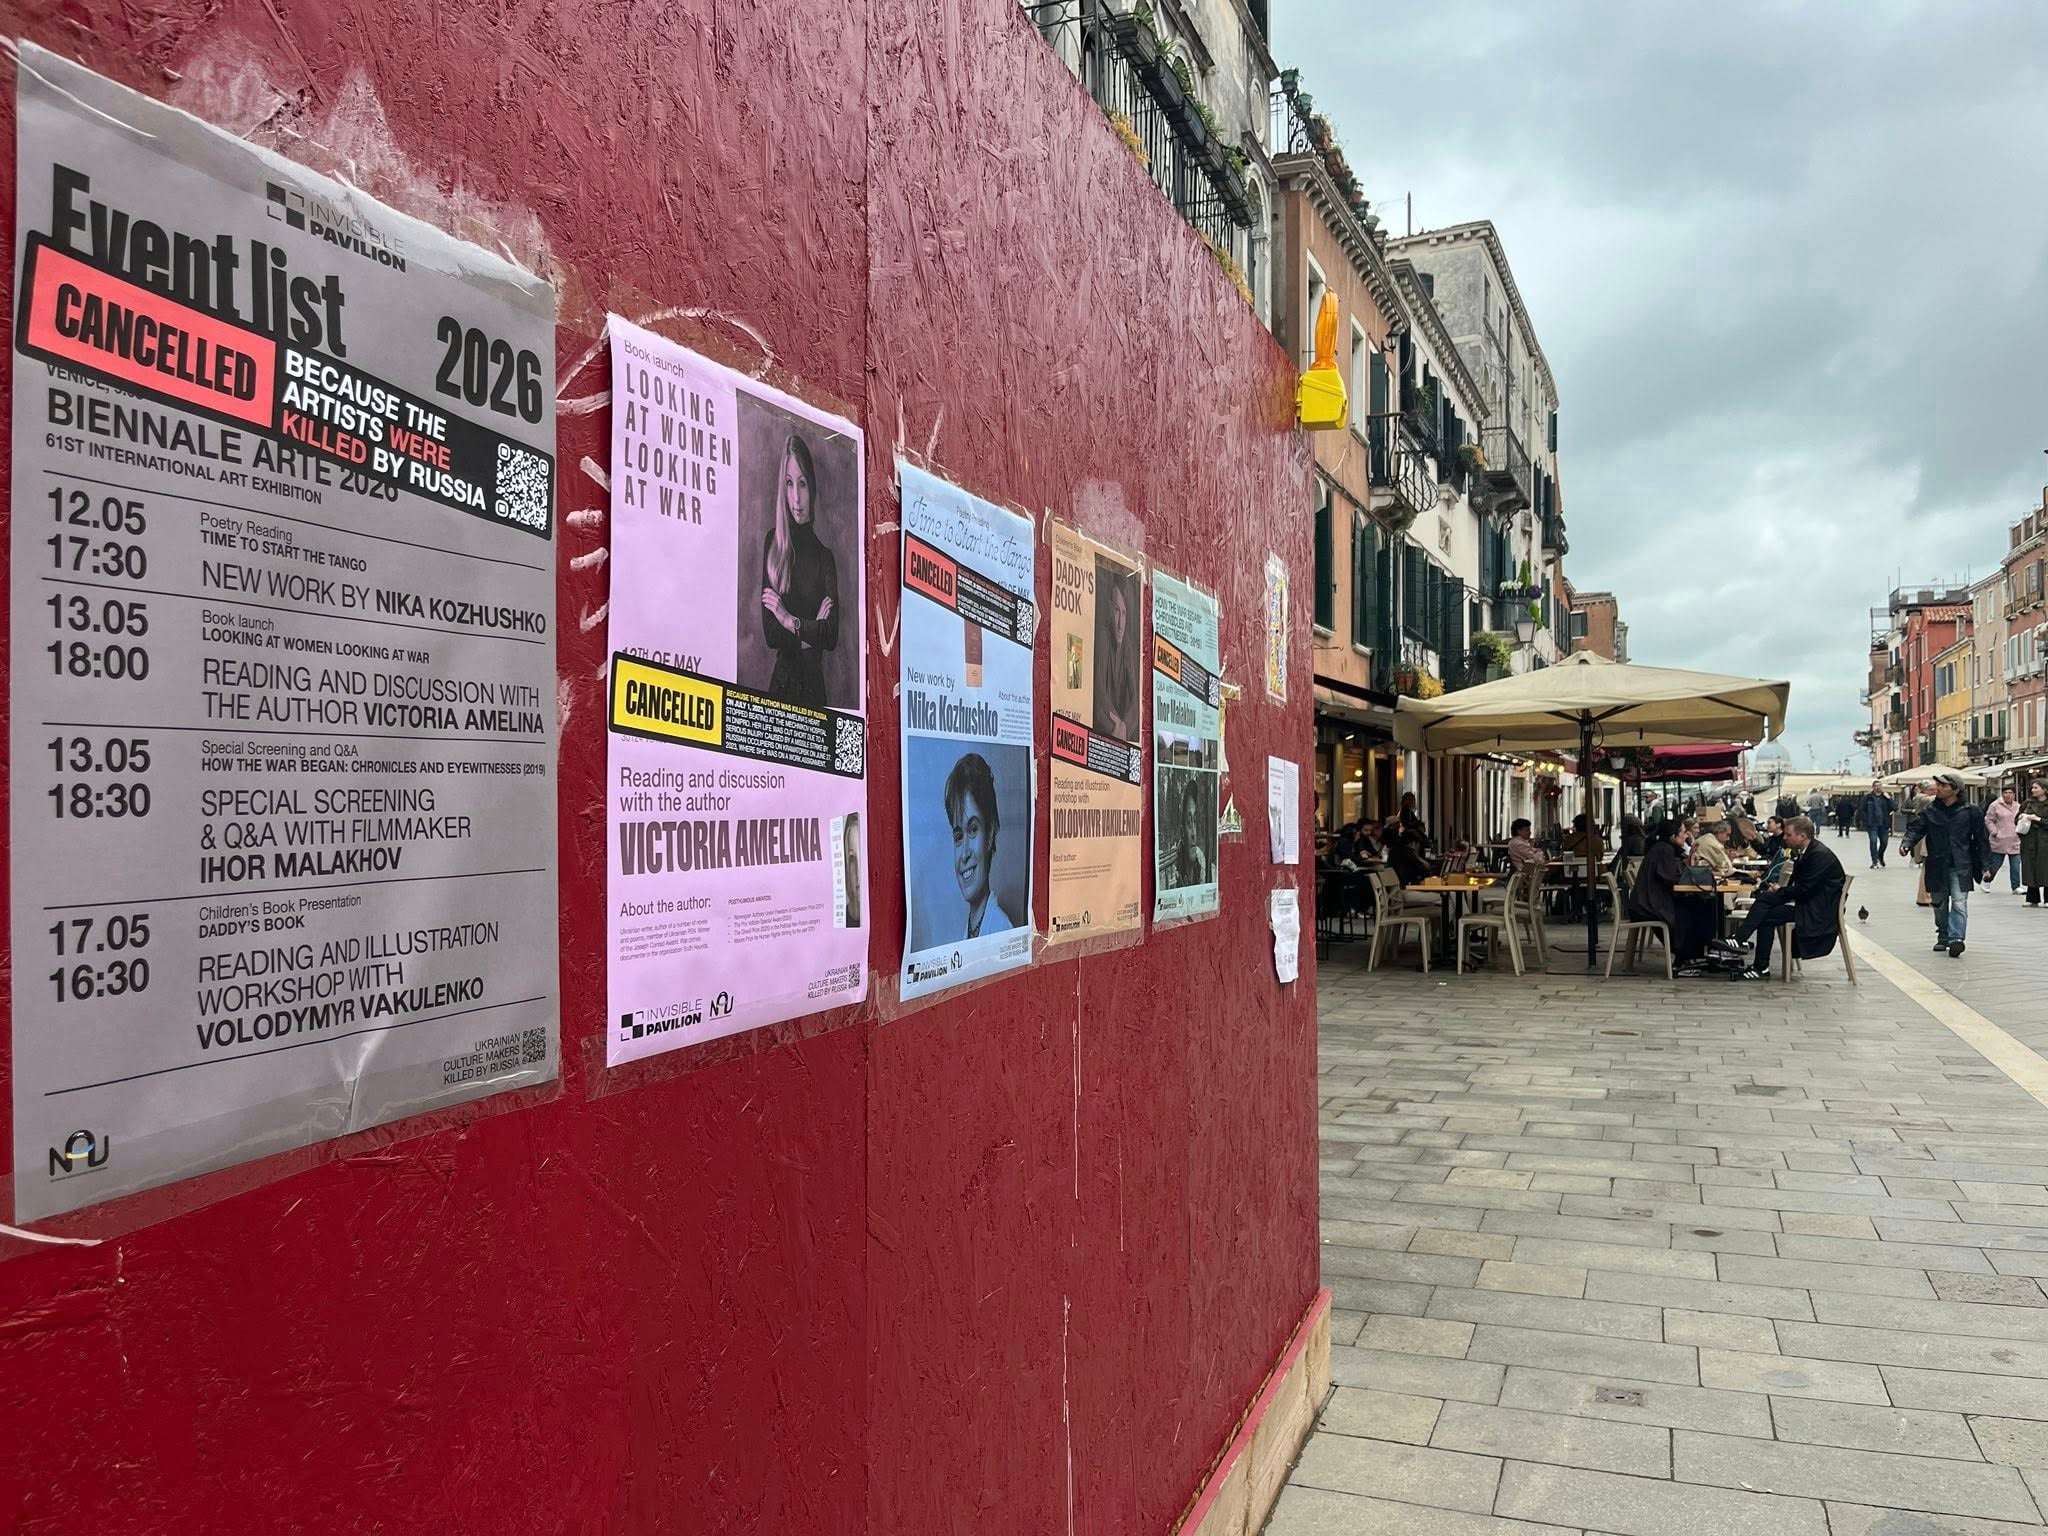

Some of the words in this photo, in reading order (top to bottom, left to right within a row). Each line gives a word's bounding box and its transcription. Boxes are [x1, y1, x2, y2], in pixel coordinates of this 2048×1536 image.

[310, 220, 407, 273] PAVILION
[311, 200, 404, 252] INVISIBLE
[53, 162, 240, 320] Event
[251, 239, 346, 358] list
[55, 283, 257, 402] CANCELLED
[624, 339, 651, 364] Book
[652, 355, 685, 378] launch
[436, 316, 542, 425] 2026
[285, 349, 400, 421] BECAUSE
[405, 402, 447, 441] THE
[626, 363, 715, 427] LOOKING
[48, 387, 242, 464] BIENNALE
[252, 439, 332, 486] ARTE
[282, 382, 384, 442] ARTISTS
[389, 424, 451, 471] WERE
[625, 400, 649, 436] AT
[661, 413, 731, 467] WOMEN
[46, 433, 84, 455] 61ST
[89, 443, 215, 481] INTERNATIONAL
[219, 470, 249, 488] ART
[252, 476, 322, 505] EXHIBITION
[282, 410, 367, 464] KILLED
[373, 447, 405, 478] BY
[409, 463, 487, 511] RUSSIA
[624, 437, 717, 496] LOOKING
[47, 487, 147, 536] 12.05
[624, 475, 647, 510] AT
[660, 485, 702, 525] WAR
[200, 512, 243, 535] Poetry
[247, 519, 293, 544] Reading
[908, 496, 942, 538] Time
[943, 518, 954, 543] to
[955, 520, 982, 555] Start
[1000, 536, 1031, 579] Tango
[47, 534, 147, 580] 17:30
[200, 530, 236, 549] TIME
[240, 536, 259, 553] TO
[262, 541, 301, 560] START
[302, 548, 325, 565] THE
[328, 553, 367, 572] TANGO
[910, 551, 953, 597] CANCELLED
[1056, 558, 1094, 595] DADDY'S
[47, 593, 149, 637] 13.05
[202, 560, 262, 594] NEW
[267, 571, 336, 606] WORK
[341, 583, 371, 610] BY
[376, 589, 425, 619] NIKA
[430, 597, 546, 635] KOZHUSHKO
[1054, 584, 1082, 616] BOOK
[202, 609, 236, 628] Book
[238, 613, 275, 632] launch
[47, 640, 149, 681] 18:00
[202, 628, 263, 648] LOOKING
[265, 634, 281, 650] AT
[283, 637, 333, 654] WOMEN
[336, 643, 390, 661] LOOKING
[392, 648, 405, 663] AT
[407, 650, 430, 665] WAR
[652, 651, 671, 665] OF
[674, 653, 702, 673] MAY
[203, 657, 311, 692] READING
[318, 668, 367, 696] AND
[373, 673, 495, 705] DISCUSSION
[499, 683, 540, 708] WITH
[907, 667, 925, 683] New
[927, 673, 945, 688] work
[946, 675, 956, 692] by
[202, 691, 251, 720] THE
[256, 694, 358, 726] AUTHOR
[363, 701, 460, 731] VICTORIA
[464, 709, 545, 734] AMELINA
[625, 679, 715, 731] CANCELLED
[907, 689, 937, 731] Nika
[939, 694, 998, 737] Kozhushko
[47, 736, 152, 774] 13.05
[201, 740, 245, 756] Special
[247, 741, 307, 759] Screening
[309, 743, 332, 757] and
[333, 743, 359, 757] Q&A
[1056, 727, 1085, 757] CANCELLED
[201, 758, 235, 773] HOW
[236, 758, 263, 773] THE
[265, 759, 298, 774] WAR
[301, 759, 349, 774] BEGAN:
[351, 760, 418, 775] CHRONICLES
[419, 762, 444, 775] AND
[447, 762, 522, 775] EYEWITNESSES
[523, 762, 546, 777] (2019)
[620, 767, 684, 793] Reading
[688, 771, 715, 789] and
[719, 770, 785, 789] discussion
[1054, 776, 1074, 792] Reading
[1074, 780, 1084, 791] and
[47, 782, 152, 820] 18:30
[201, 789, 308, 817] SPECIAL
[313, 788, 436, 815] SCREENING
[620, 792, 653, 812] with
[657, 792, 682, 812] the
[686, 793, 731, 812] author
[200, 823, 217, 850] &
[224, 822, 278, 850] Q&A
[284, 819, 346, 847] WITH
[351, 816, 472, 843] FILMMAKER
[1053, 808, 1101, 839] VOLODYMYR
[1101, 809, 1140, 837] VAKULENKO
[200, 854, 266, 884] IHOR
[274, 846, 403, 879] MALAKHOV
[619, 820, 733, 876] VICTORIA
[735, 817, 823, 868] AMELINA
[199, 903, 260, 921] Children's
[262, 900, 296, 916] Book
[299, 894, 362, 913] Presentation
[199, 919, 261, 939] DADDY'S
[264, 915, 306, 933] BOOK
[620, 899, 655, 918] About
[657, 898, 674, 914] the
[676, 896, 712, 912] author:
[48, 914, 151, 956] 17.05
[199, 945, 313, 983] READING
[320, 938, 360, 967] AND
[366, 921, 499, 960] ILLUSTRATION
[48, 958, 151, 1003] 16:30
[198, 970, 345, 1017] WORKSHOP
[349, 961, 404, 991] WITH
[196, 1001, 355, 1051] VOLODYMYR
[360, 976, 484, 1020] VAKULENKO
[646, 1012, 702, 1037] PAVILION
[647, 998, 703, 1022] INVISIBLE
[443, 1052, 484, 1073] CULTURE
[485, 1044, 521, 1065] MAKERS
[474, 1031, 521, 1053] UKRAINIAN
[444, 1068, 476, 1085] KILLED
[476, 1064, 490, 1079] BY
[490, 1058, 521, 1075] RUSSIA
